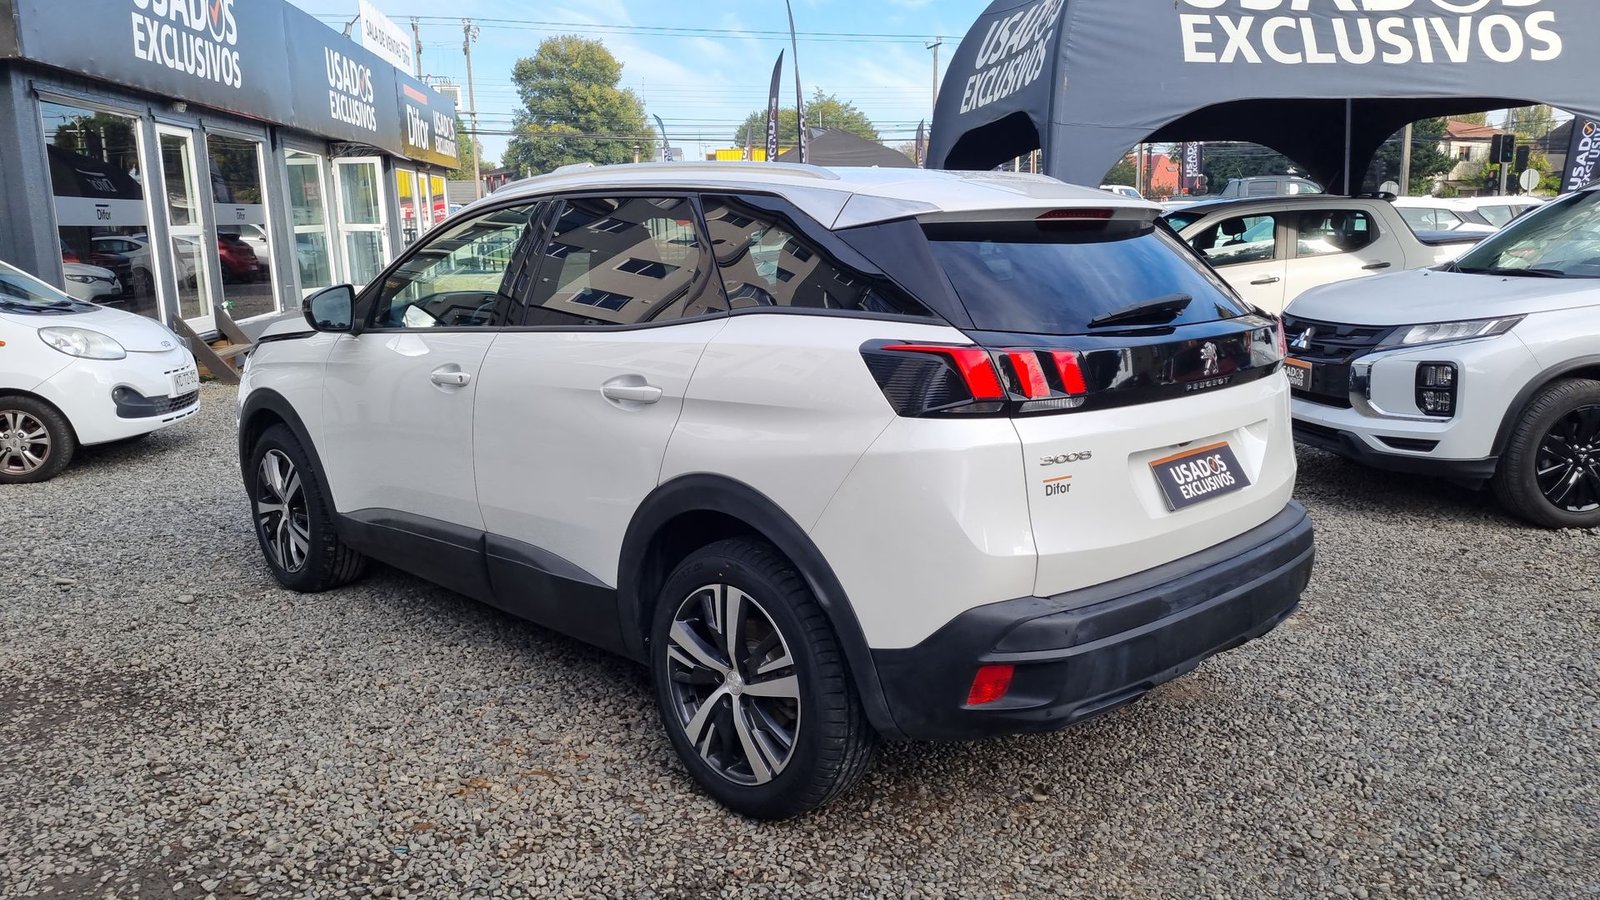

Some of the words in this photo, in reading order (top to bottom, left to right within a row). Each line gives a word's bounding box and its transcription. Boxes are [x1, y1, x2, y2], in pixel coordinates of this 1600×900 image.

[131, 12, 242, 89] EXCLUSIVOS
[975, 0, 1063, 69] USADOS
[1178, 10, 1563, 65] EXCLUSIVOS
[324, 46, 374, 104] USADOS
[960, 29, 1053, 114] EXCLUSIVOS
[328, 89, 377, 132] EXCLUSIVOS
[406, 103, 430, 150] Difor
[432, 109, 455, 141] USADOS
[1186, 142, 1195, 178] USADO
[1567, 121, 1597, 191] USADO
[96, 209, 112, 221] Difor
[1186, 377, 1230, 391] PEUGEOT
[1039, 450, 1092, 466] 3008
[1169, 453, 1228, 485] USADOS
[1045, 482, 1072, 497] Difor
[1180, 471, 1236, 500] EXCLUSIVOS
